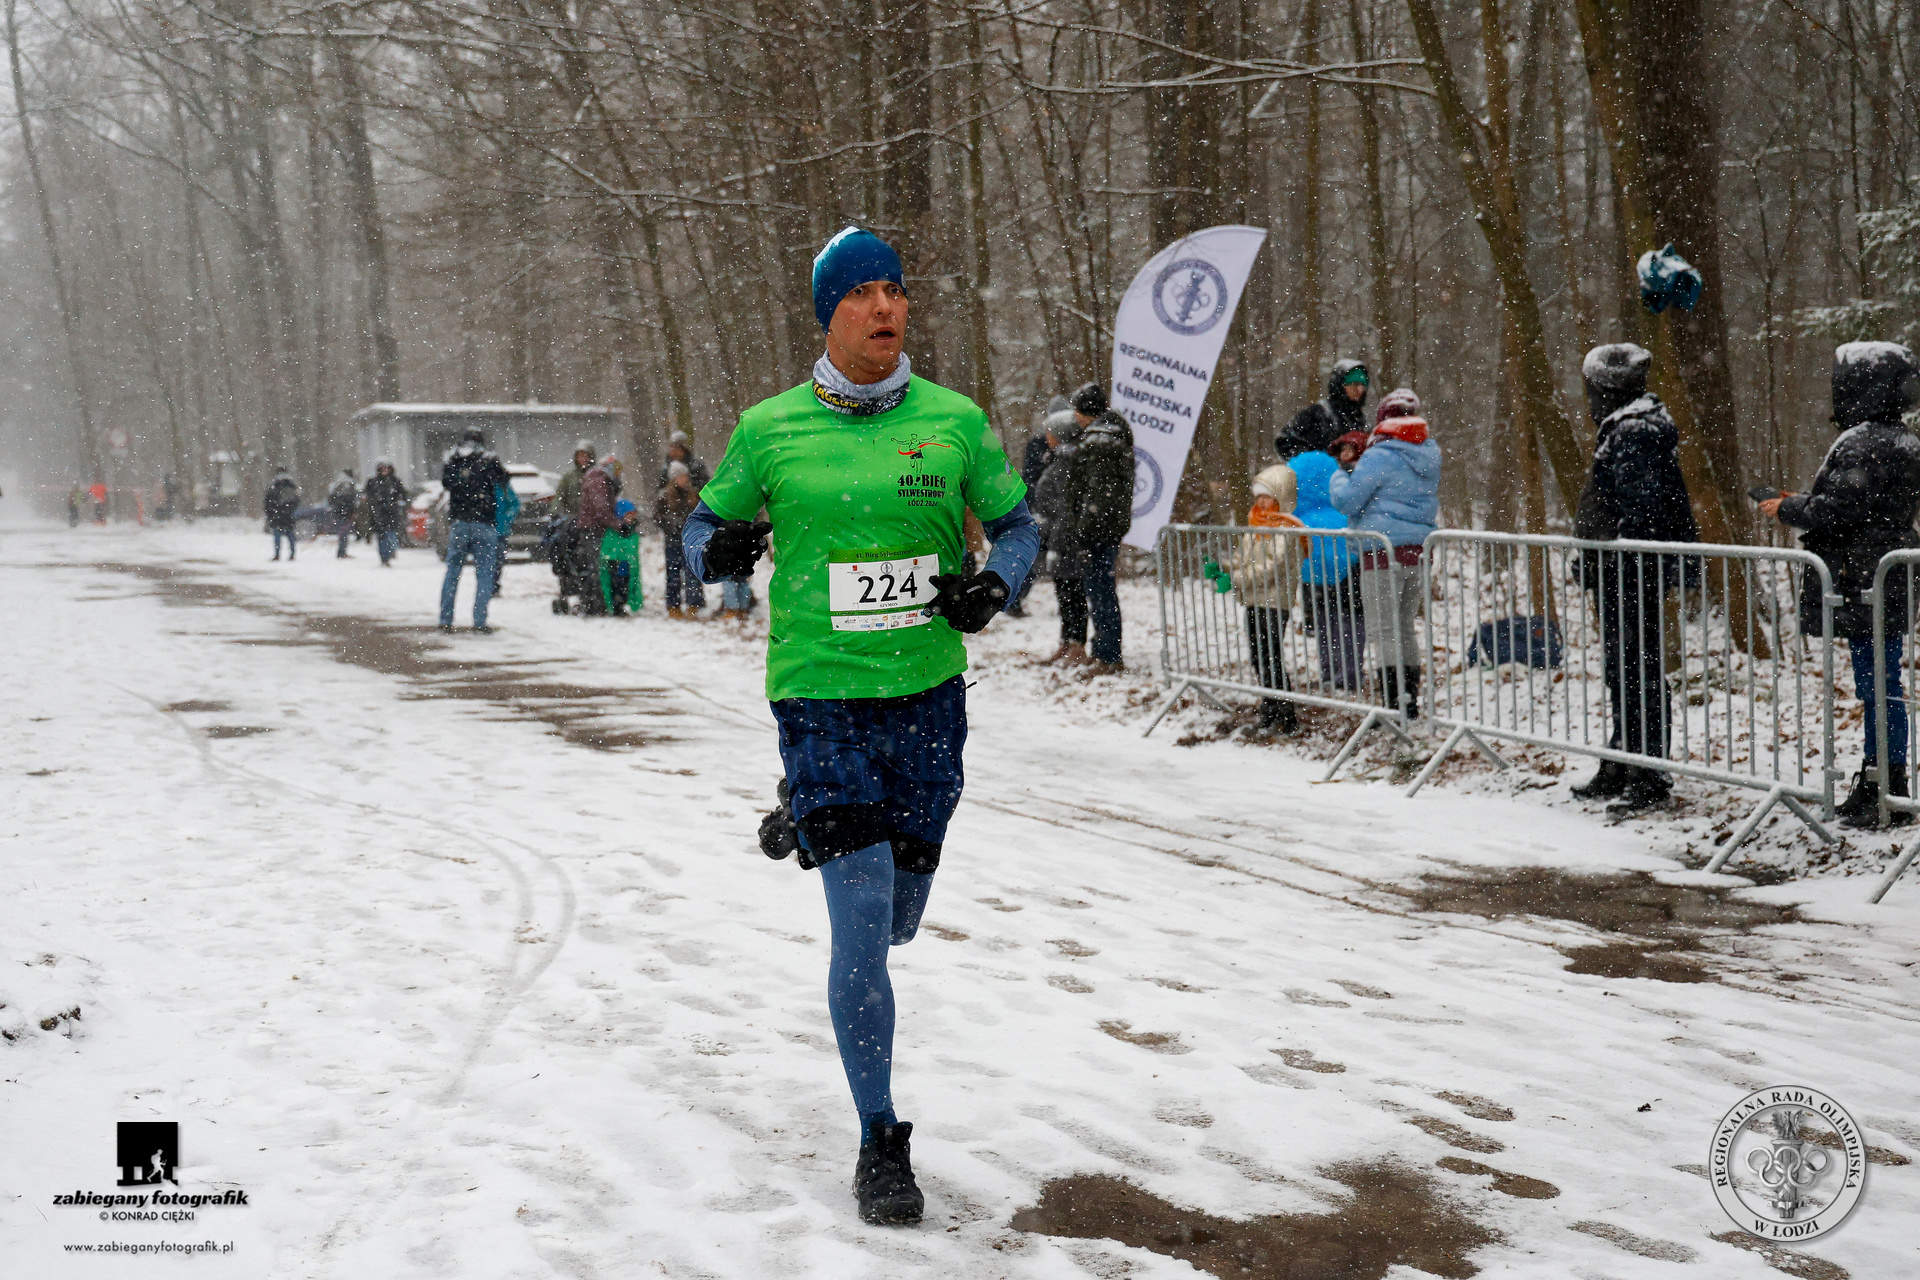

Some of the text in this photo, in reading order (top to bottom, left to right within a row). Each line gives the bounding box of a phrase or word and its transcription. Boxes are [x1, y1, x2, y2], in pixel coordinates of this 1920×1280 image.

[1119, 343, 1207, 381] REGIONALNA
[1132, 367, 1175, 391] RADA
[921, 474, 946, 489] BIEG
[857, 571, 918, 603] 224
